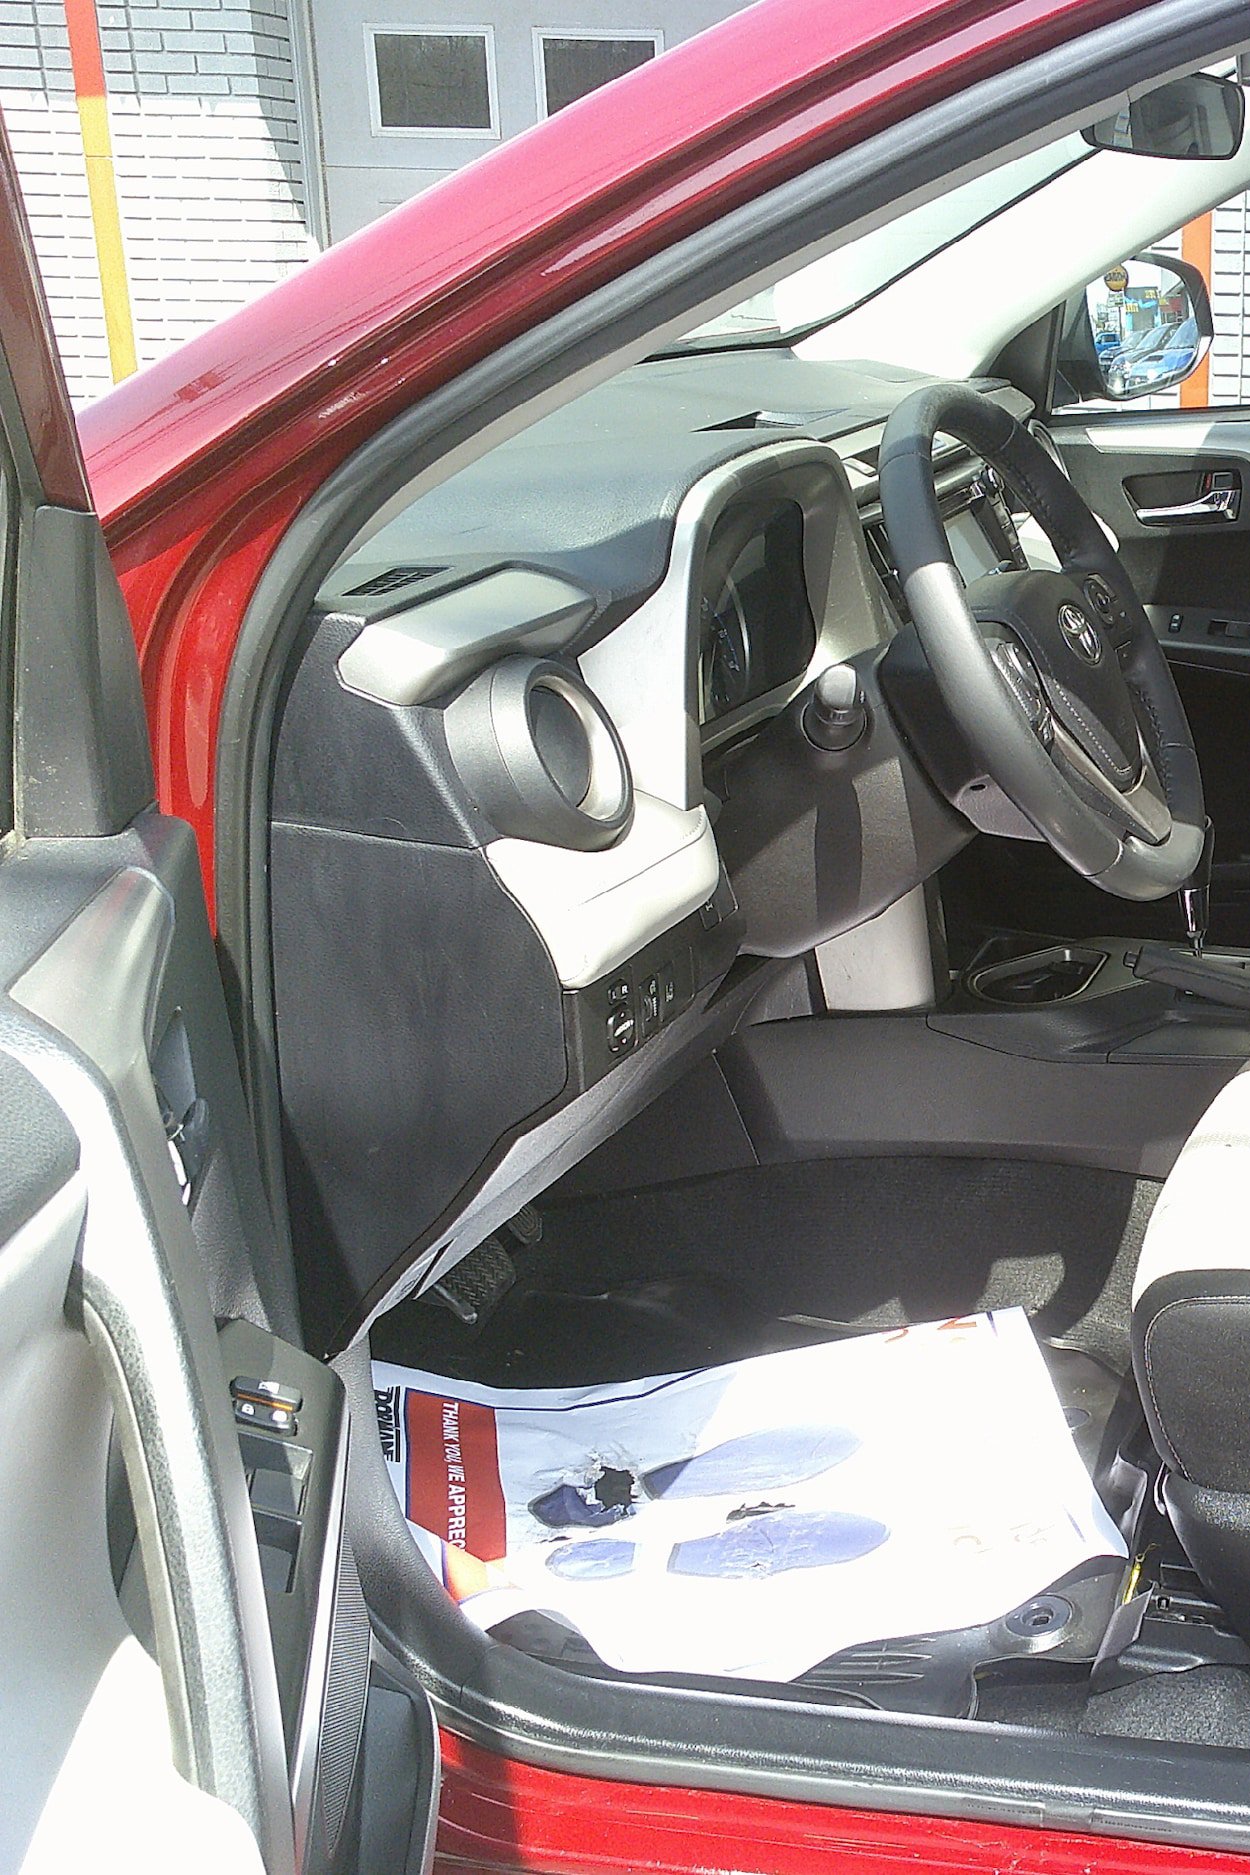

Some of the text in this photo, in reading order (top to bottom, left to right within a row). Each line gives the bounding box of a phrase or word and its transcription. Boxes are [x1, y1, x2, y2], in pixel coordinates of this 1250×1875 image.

[442, 1402, 467, 1551] THANK YOU, WE APPREC
